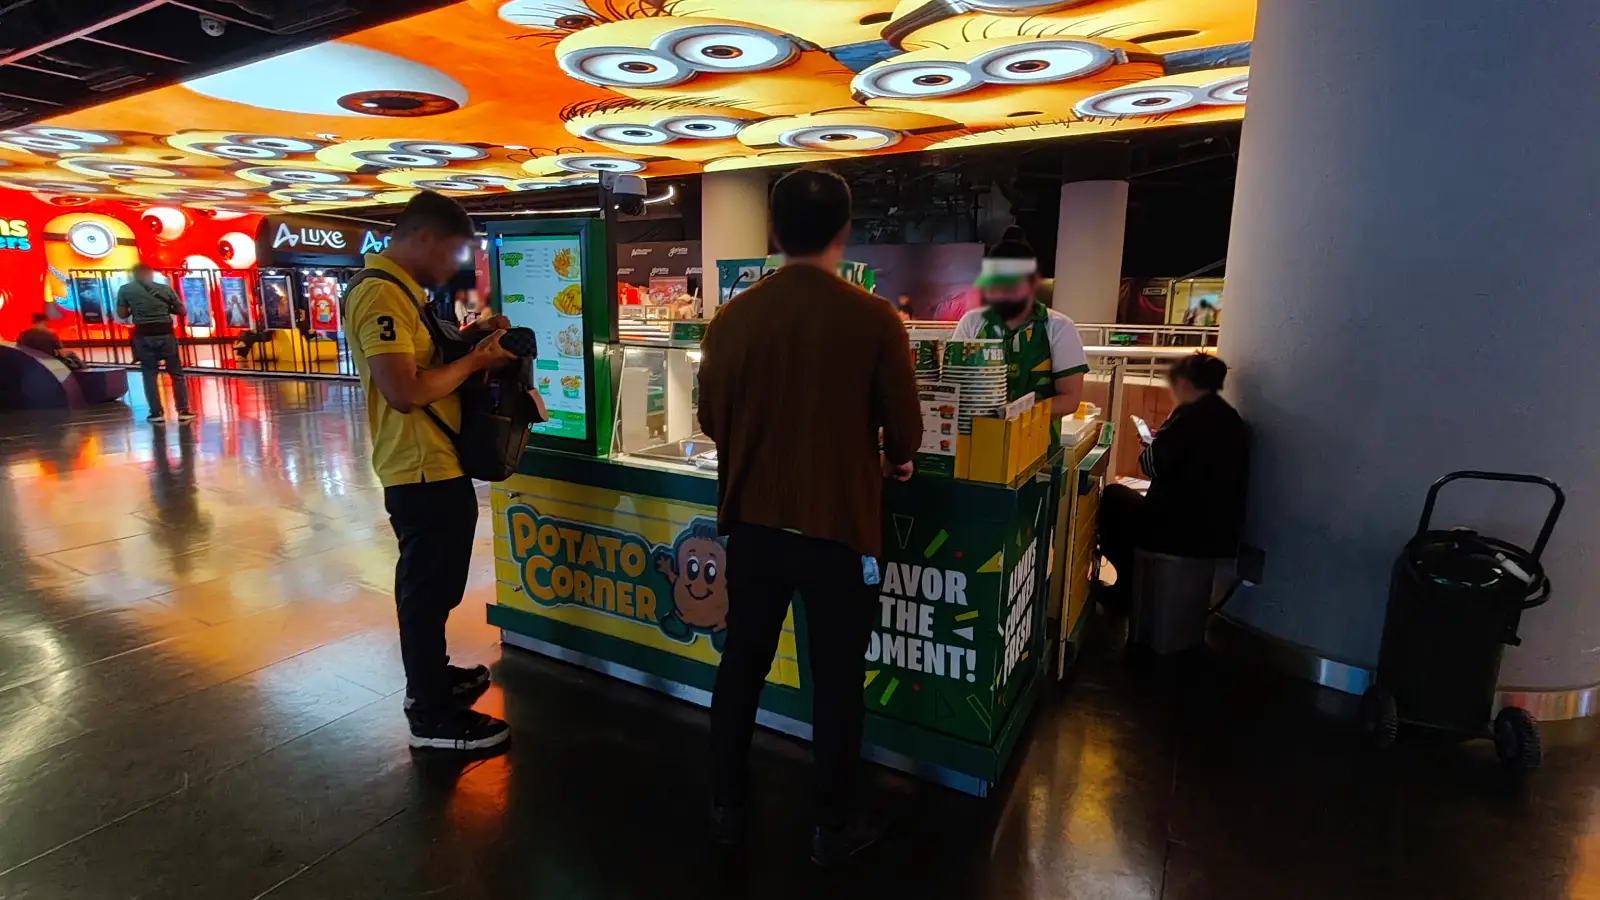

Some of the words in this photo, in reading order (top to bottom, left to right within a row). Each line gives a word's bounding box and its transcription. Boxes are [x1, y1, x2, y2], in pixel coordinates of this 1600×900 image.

[377, 315, 396, 341] 3
[512, 512, 646, 577] POTATO
[525, 555, 656, 622] CORNER
[882, 561, 968, 606] AVOR
[879, 594, 935, 639] THE
[864, 630, 977, 683] OMENT!
